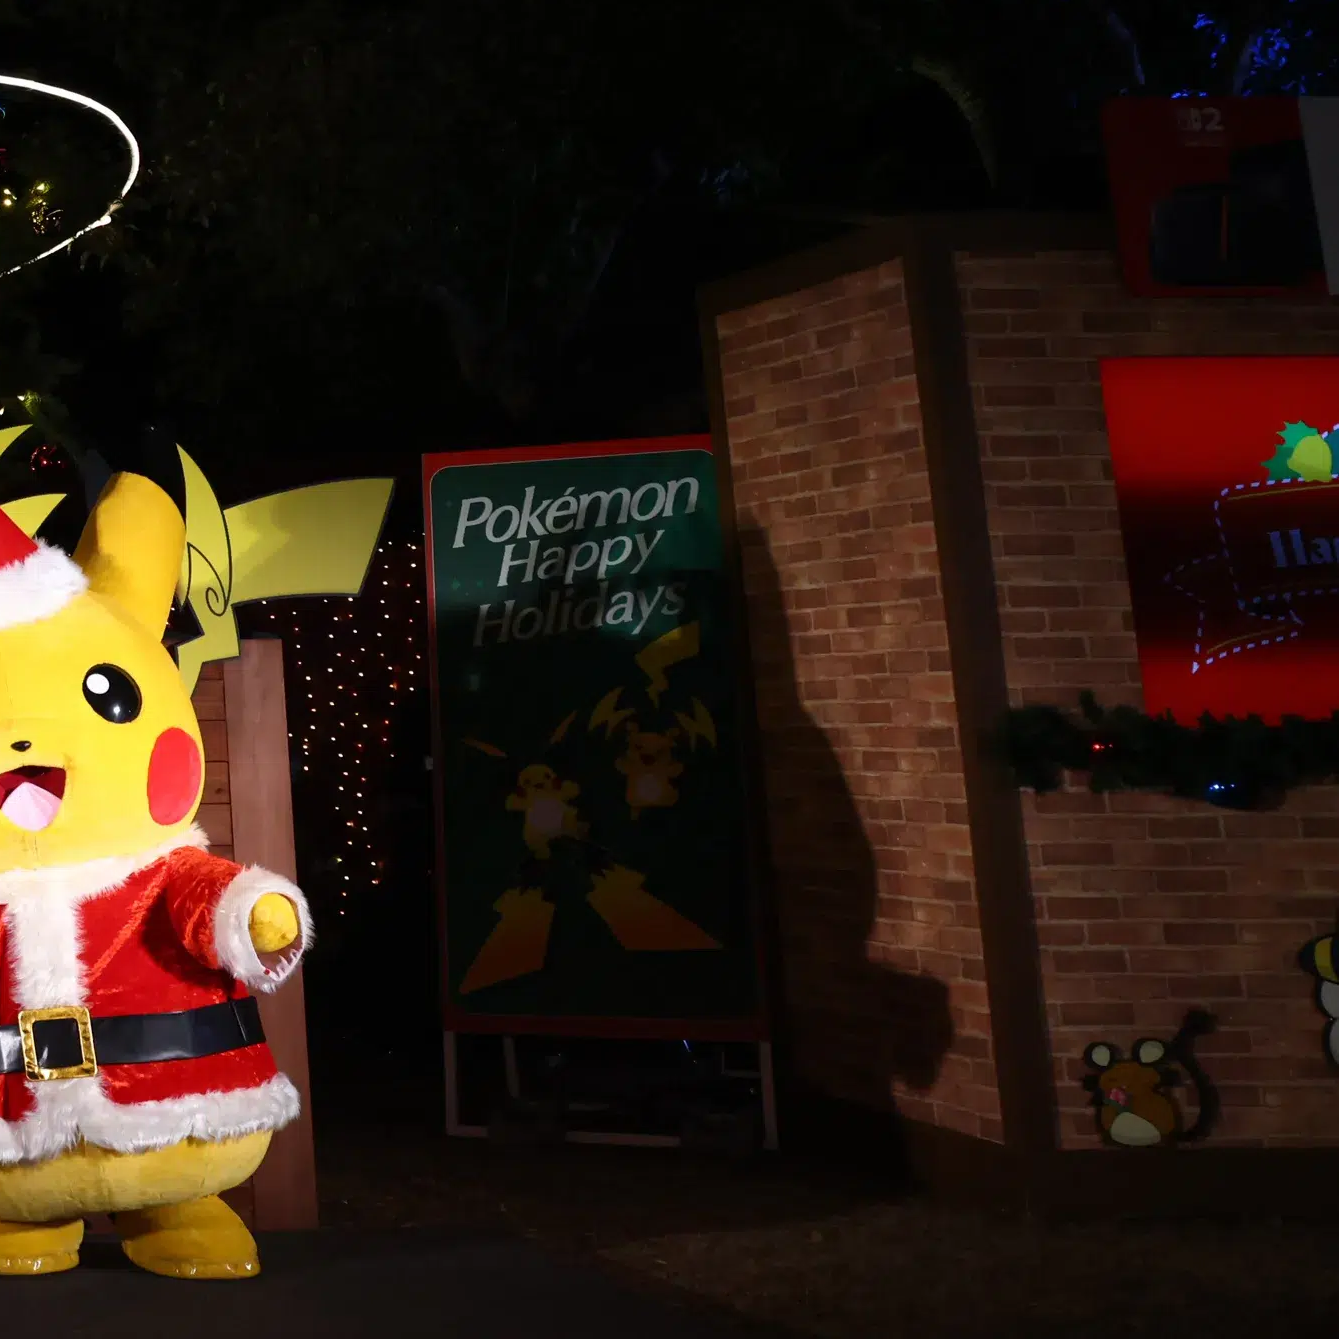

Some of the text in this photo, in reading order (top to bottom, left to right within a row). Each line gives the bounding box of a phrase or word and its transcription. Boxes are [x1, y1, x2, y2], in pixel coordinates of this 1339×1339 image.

[452, 476, 700, 549] Pokémon
[496, 529, 666, 587] Happy
[1267, 527, 1339, 568] Ha
[472, 580, 688, 648] Holidays
